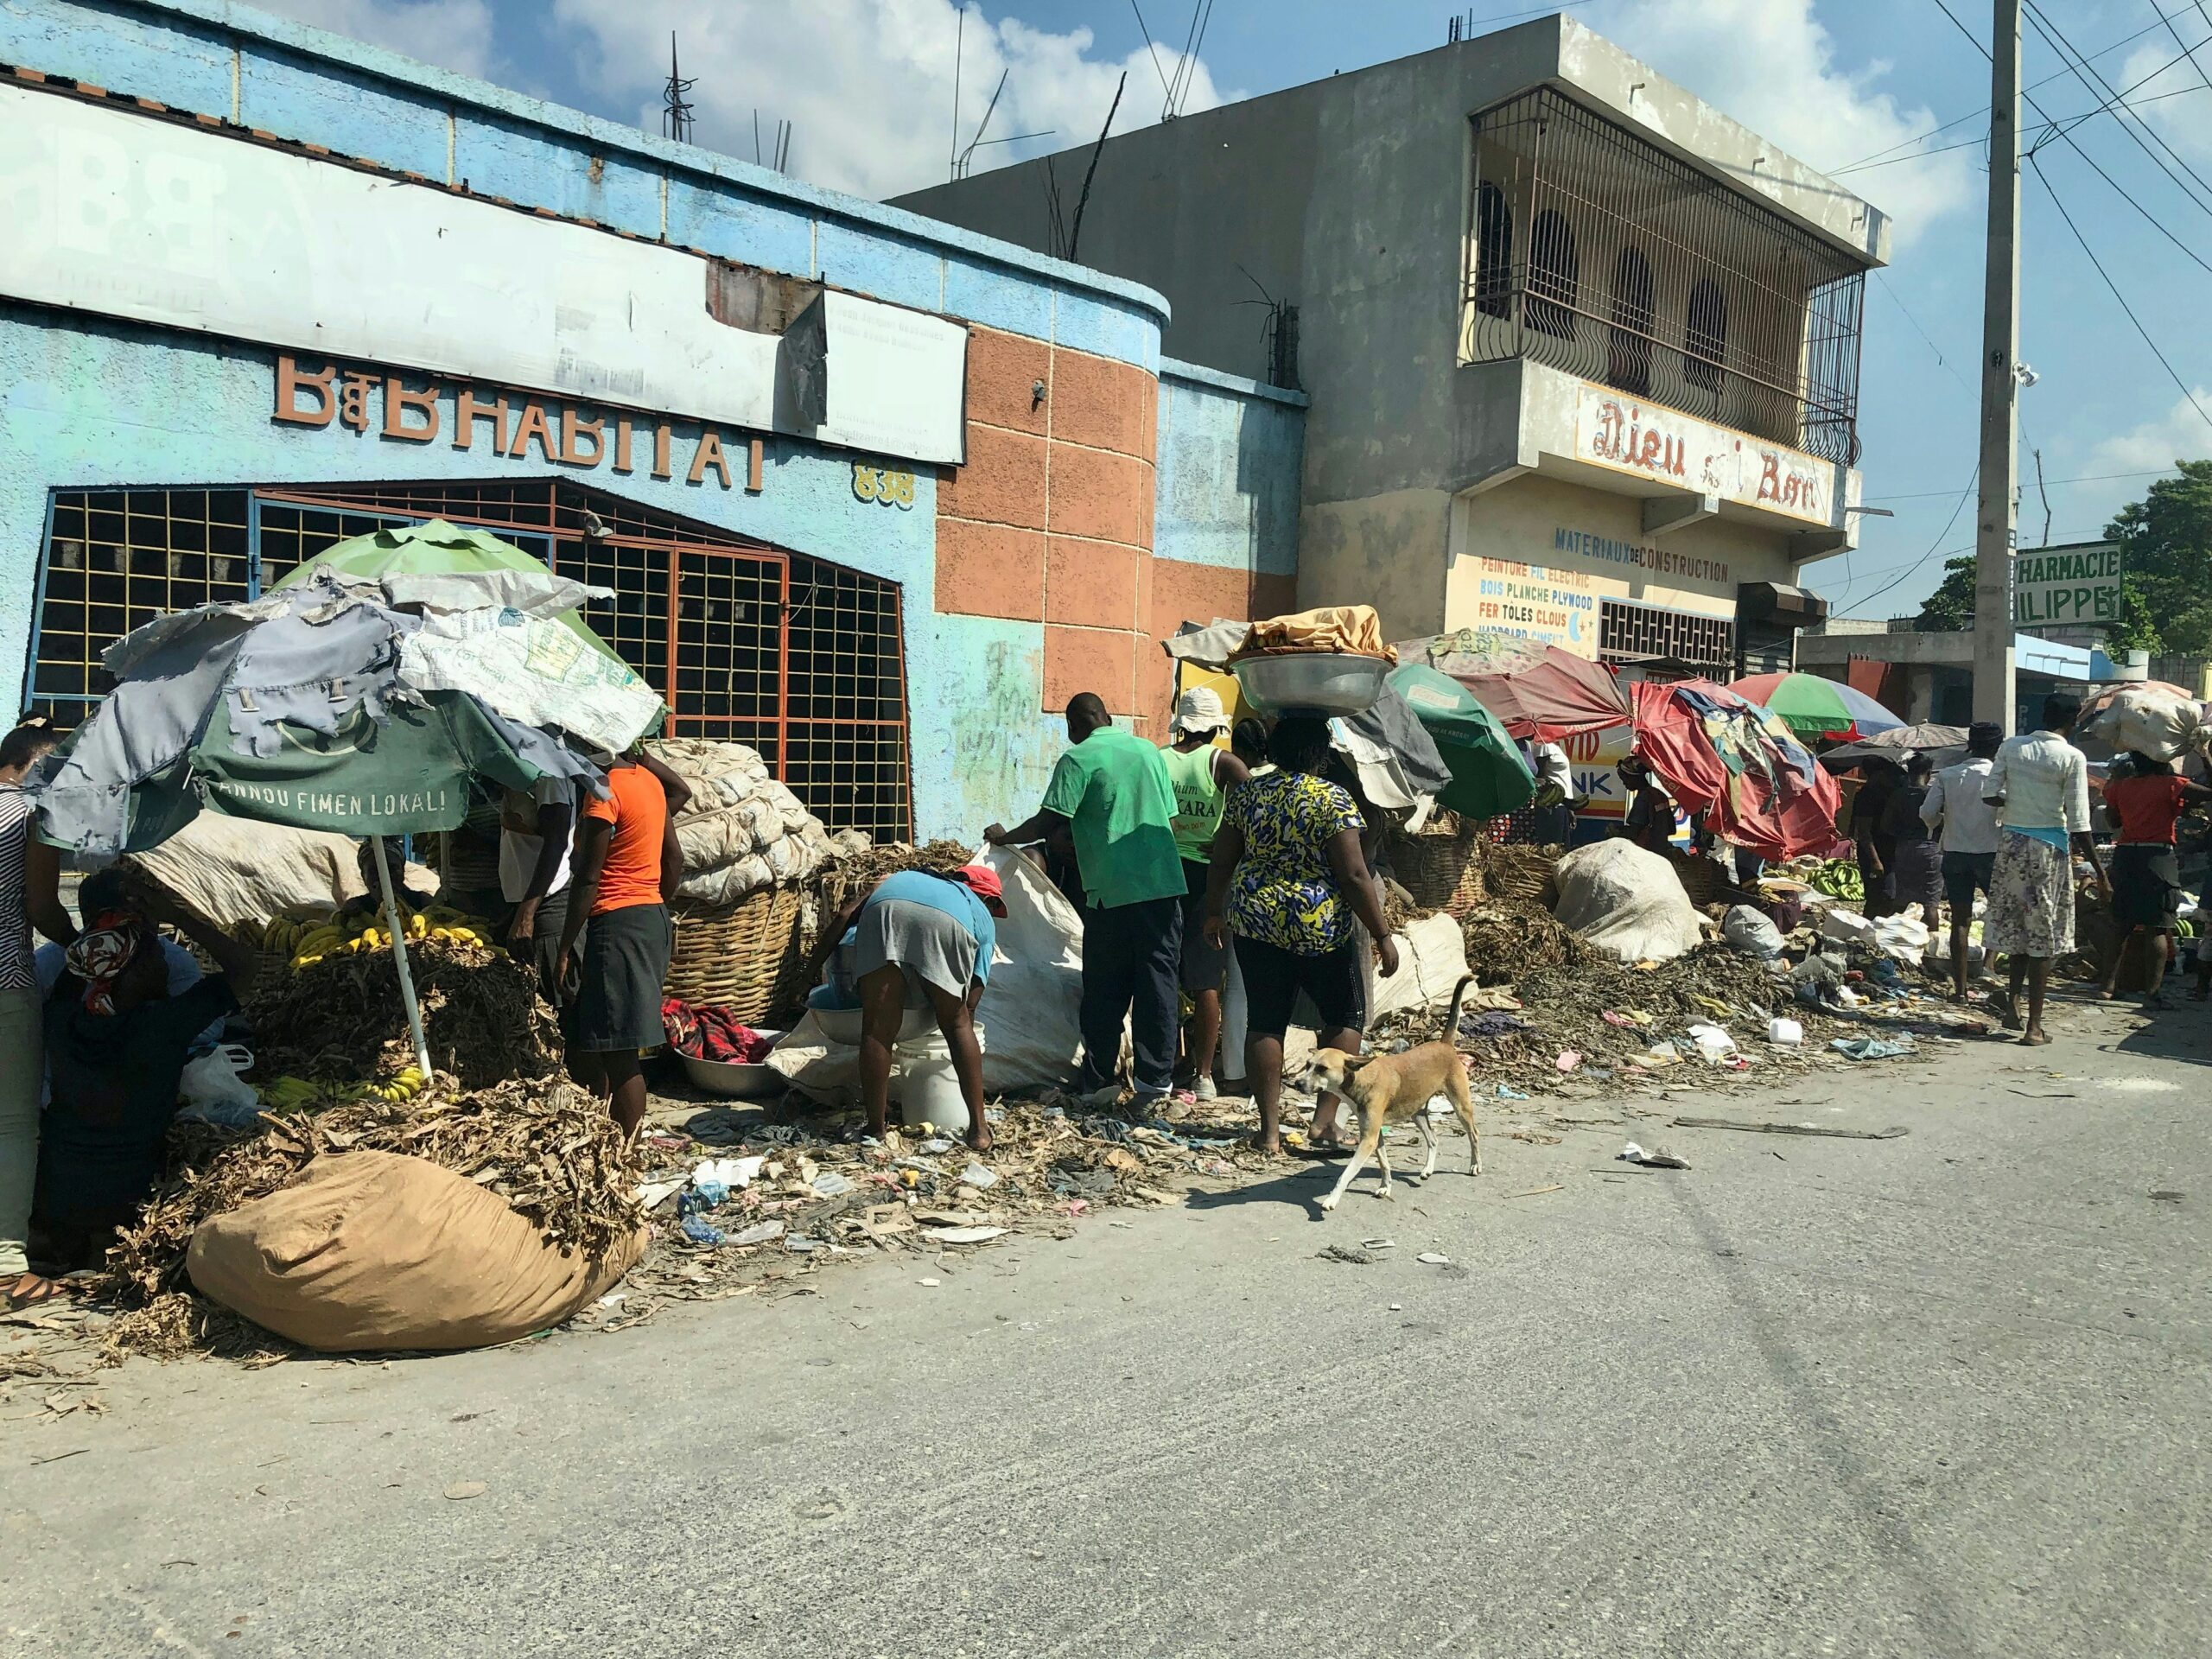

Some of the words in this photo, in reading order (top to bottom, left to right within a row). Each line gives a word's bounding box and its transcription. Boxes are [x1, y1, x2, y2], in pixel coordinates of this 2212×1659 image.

[1592, 401, 1686, 476] Dieu
[1758, 449, 1816, 510] Bon
[851, 460, 915, 512] 838
[1555, 527, 1630, 564] MATERIAUX
[1630, 548, 1638, 563] DE
[1639, 547, 1728, 582] CONSTRUCTION
[2015, 550, 2120, 584] HARMACIE
[1481, 556, 1528, 577] PEINTURE
[1531, 564, 1545, 581] FIL
[1548, 568, 1590, 588] ELECTRIC
[1480, 579, 1503, 595] BOIS
[1507, 582, 1549, 603] PLANCHE
[1552, 590, 1592, 611] PLYWOOD
[2015, 586, 2111, 622] ILIPPE
[1479, 602, 1498, 619] FER
[1503, 601, 1533, 622] TÔLES
[1536, 610, 1567, 628] CLOUS
[1560, 731, 1600, 761] VID
[219, 781, 289, 807] ANNOU
[298, 791, 363, 815] FIMEN
[371, 790, 446, 816] LOKAL!
[1171, 780, 1198, 795] hum
